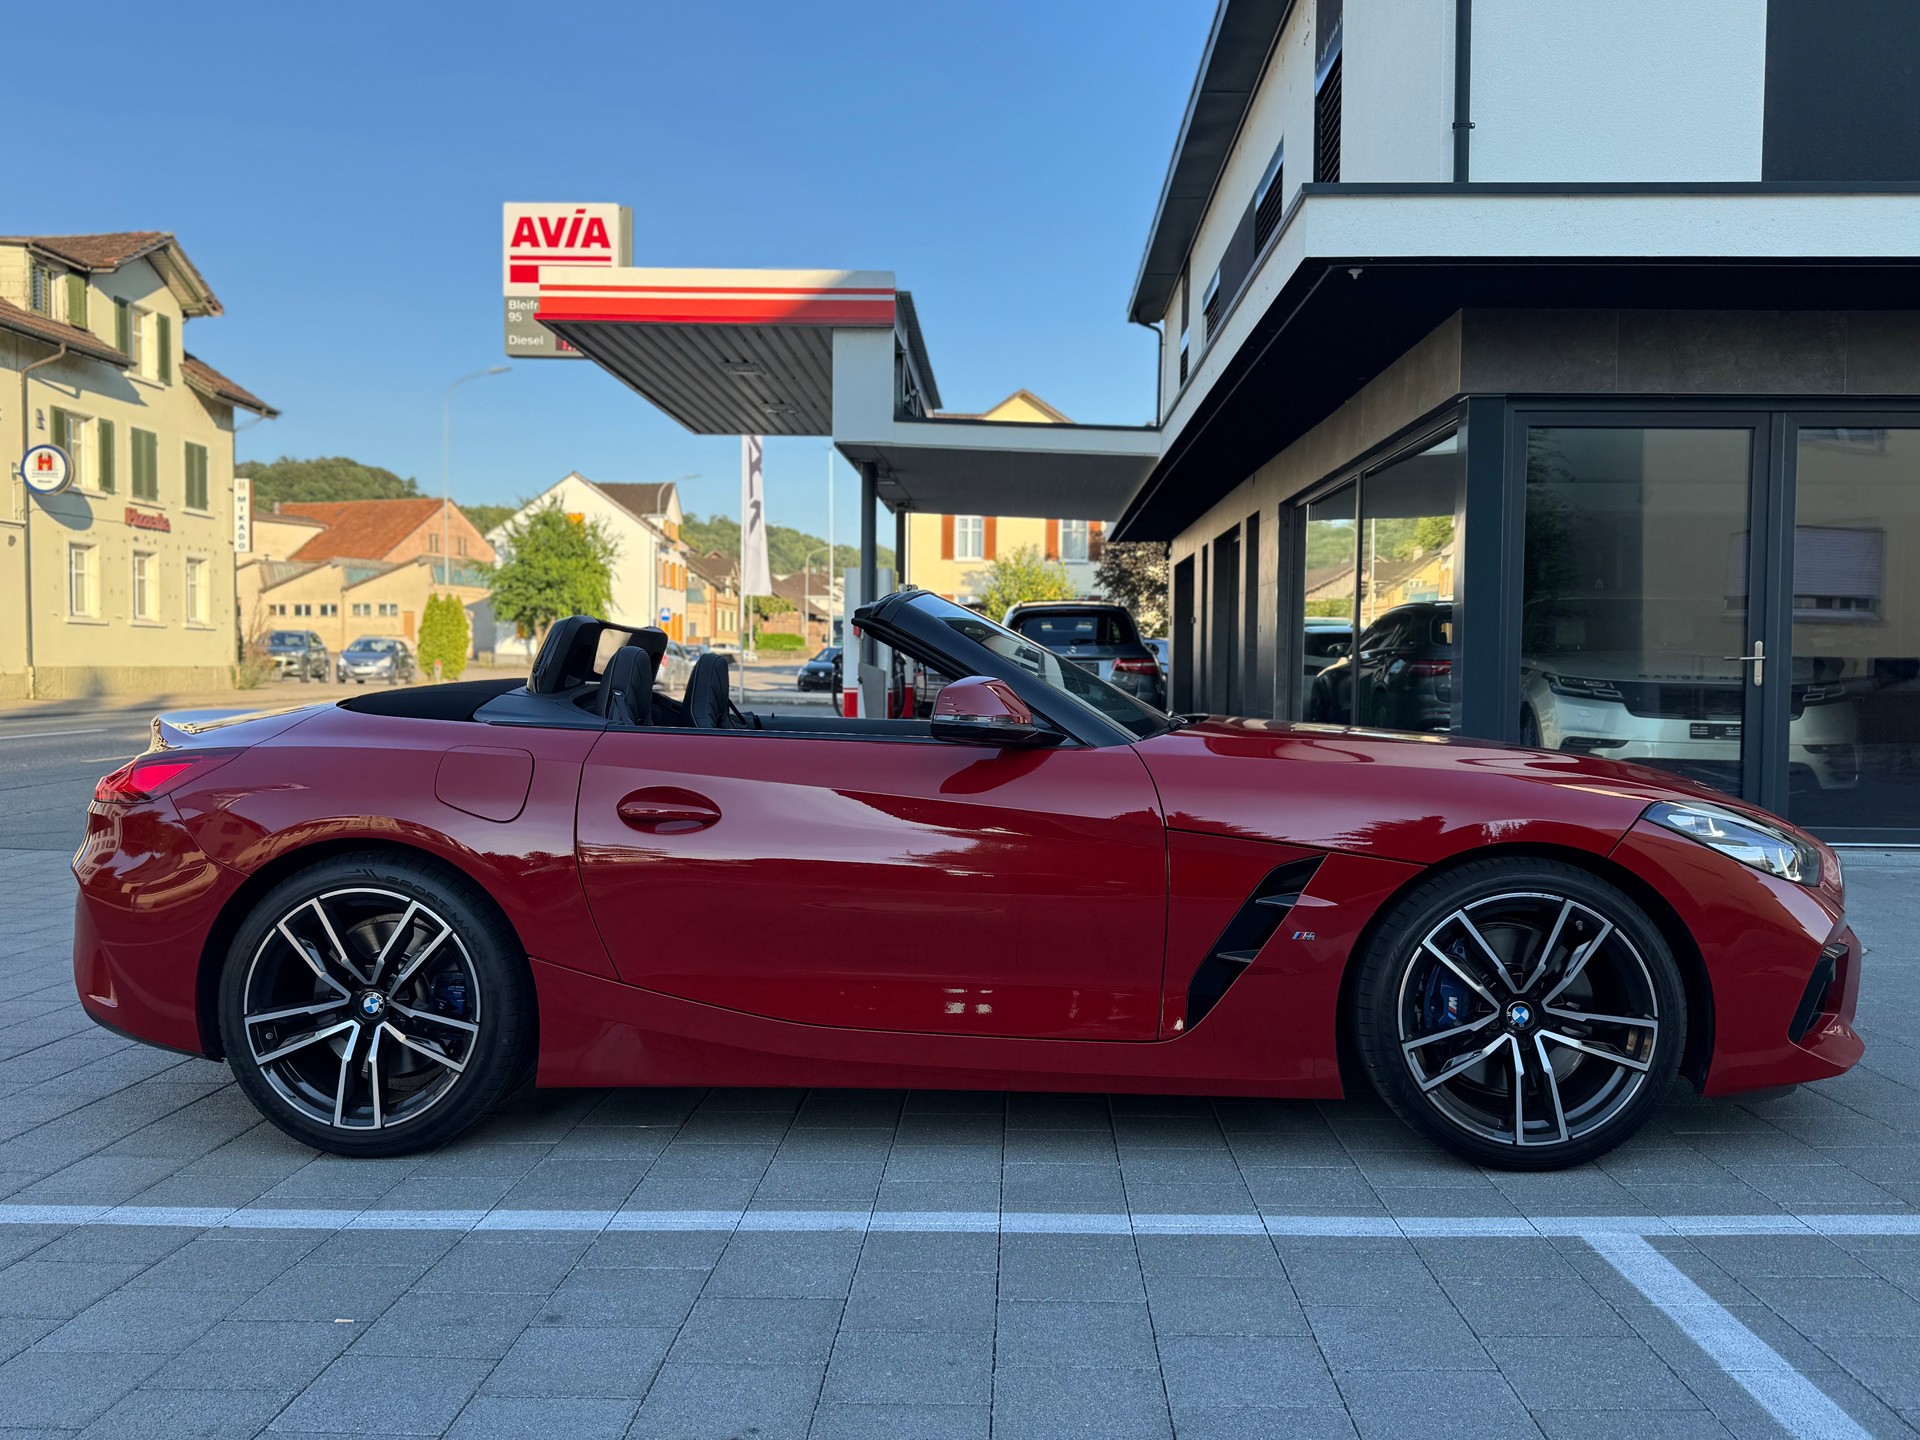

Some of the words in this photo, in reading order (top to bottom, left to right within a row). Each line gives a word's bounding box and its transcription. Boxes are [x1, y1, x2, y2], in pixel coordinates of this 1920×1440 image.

[508, 300, 539, 310] Bleifr
[508, 312, 522, 322] 95
[508, 335, 544, 345] Diesel
[237, 496, 246, 549] MIKADO
[385, 875, 450, 911] SPORT
